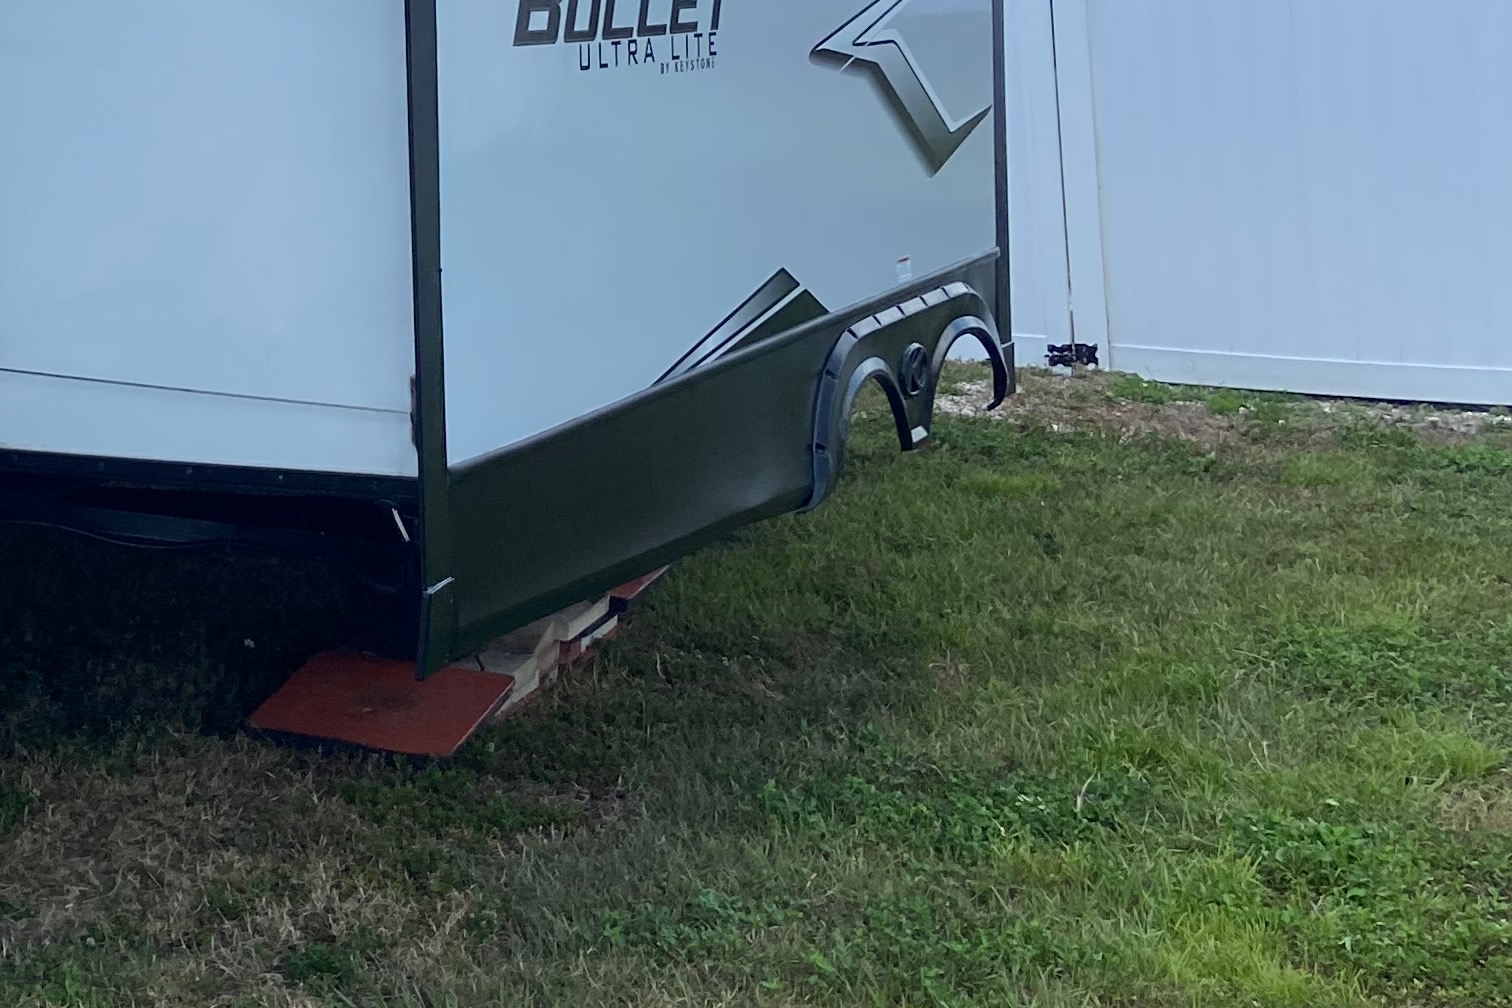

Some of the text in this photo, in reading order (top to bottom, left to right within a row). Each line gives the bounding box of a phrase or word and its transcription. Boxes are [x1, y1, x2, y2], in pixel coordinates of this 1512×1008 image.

[579, 32, 717, 70] ULTRA LITE
[661, 57, 715, 74] BY KEYSTONE
